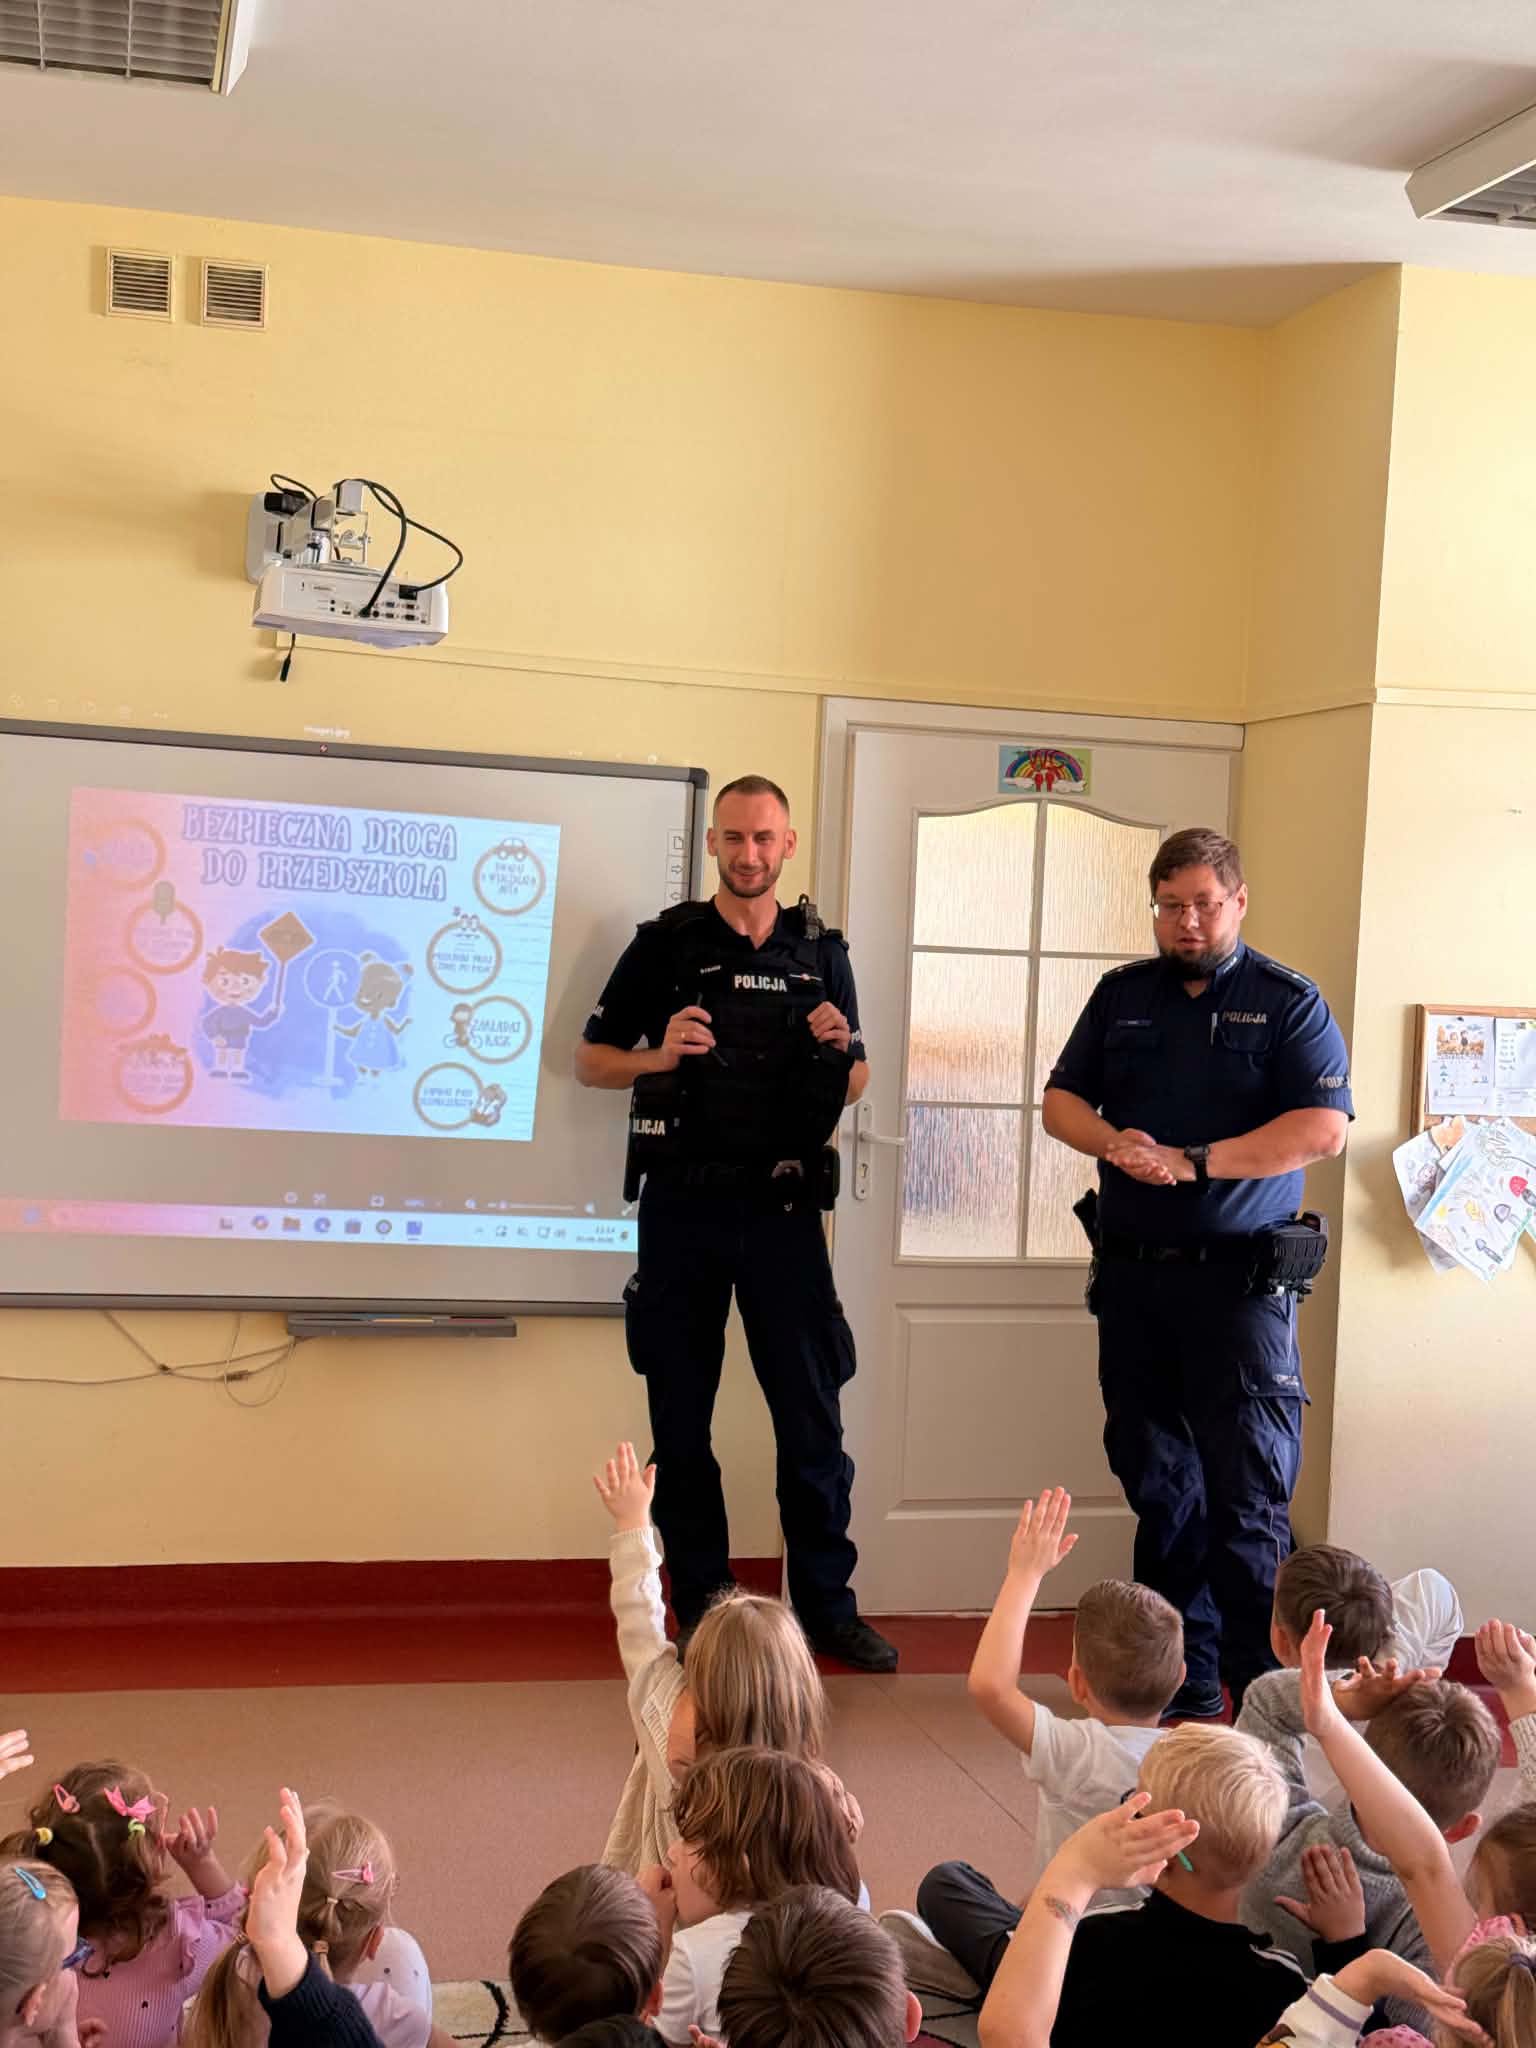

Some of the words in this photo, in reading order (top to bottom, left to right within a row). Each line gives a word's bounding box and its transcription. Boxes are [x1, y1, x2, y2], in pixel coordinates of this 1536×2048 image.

[183, 803, 351, 853] BEZPIECZNA
[361, 817, 457, 861] DROGA
[200, 847, 247, 887] DO
[256, 850, 447, 902] PRZEDSZKOLA
[734, 974, 788, 993] POLICJA
[1221, 1010, 1267, 1025] POLICJA
[632, 1118, 667, 1137] LICJA
